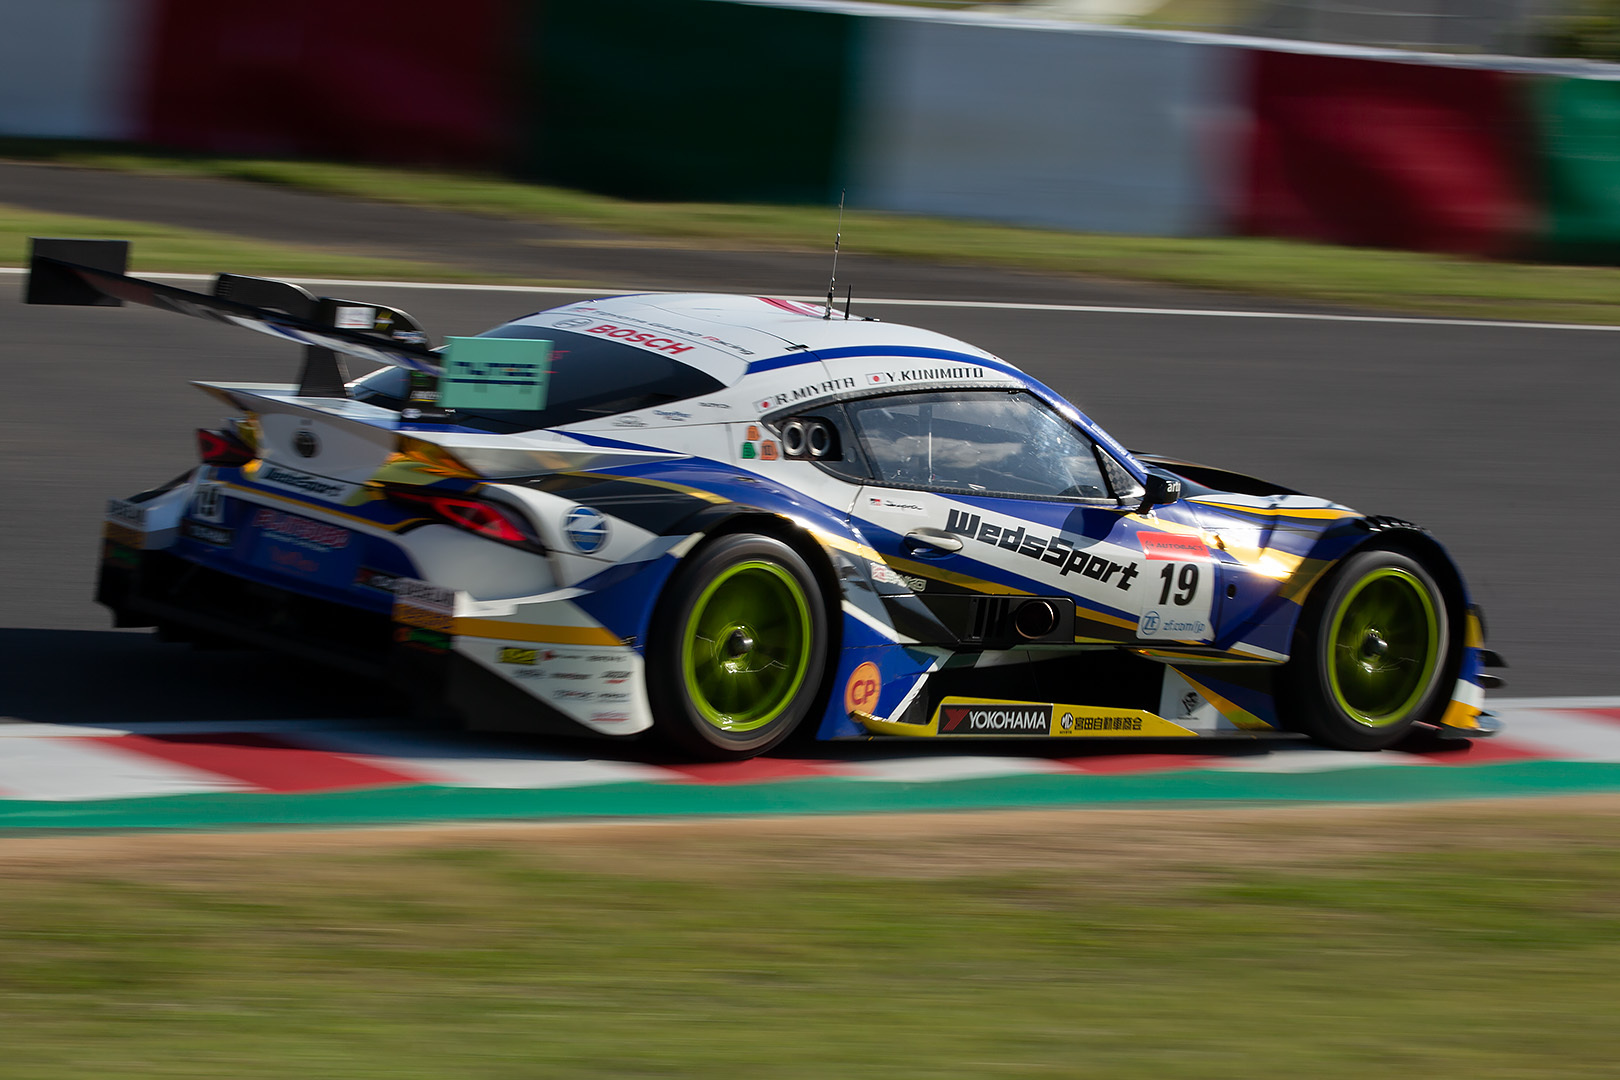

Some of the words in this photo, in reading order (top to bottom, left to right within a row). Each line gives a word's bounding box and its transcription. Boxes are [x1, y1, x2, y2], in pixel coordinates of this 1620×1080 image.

[586, 324, 696, 355] BOSCH
[886, 367, 984, 383] Y.KUNIMOTO
[776, 377, 856, 406] R.MIYATA
[944, 508, 1140, 592] WedsSport
[1158, 563, 1199, 606] 19
[852, 679, 875, 705] CP
[969, 707, 1047, 731] YOKOHAMA
